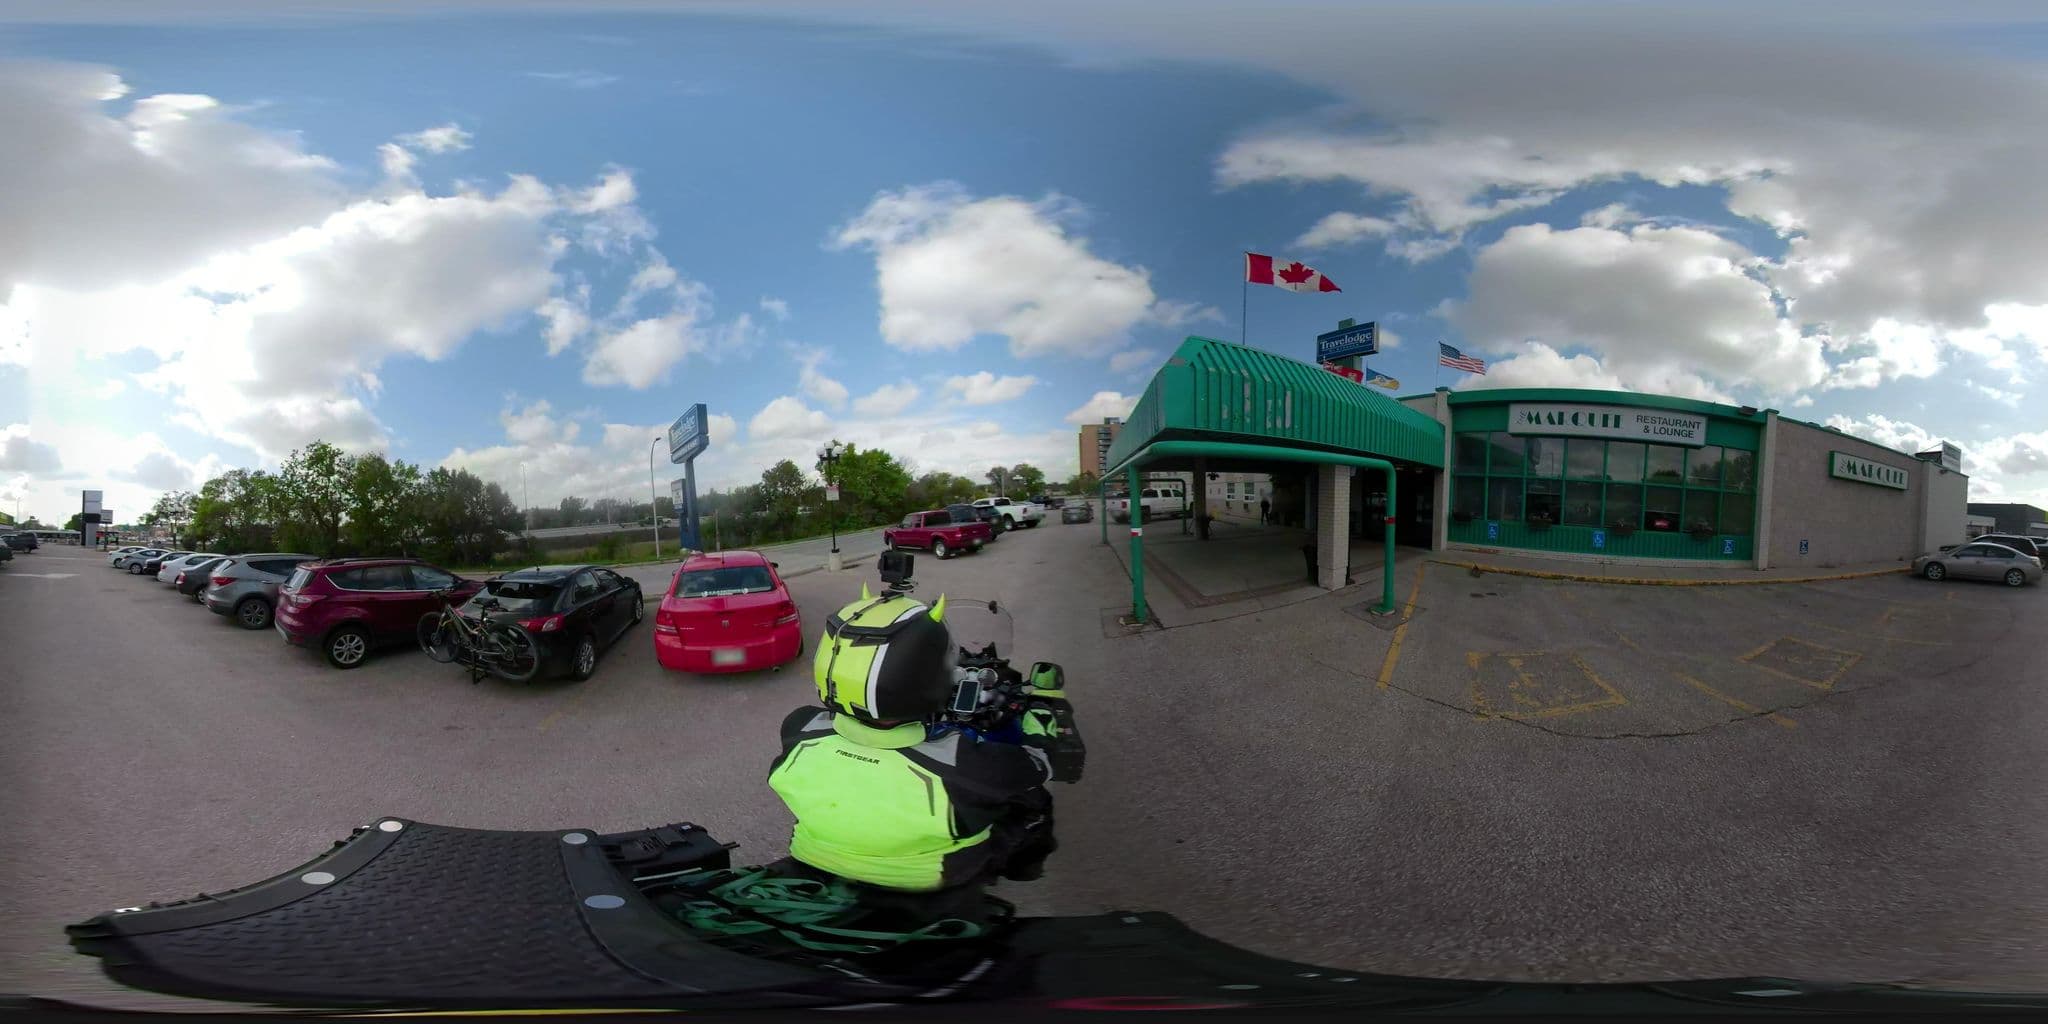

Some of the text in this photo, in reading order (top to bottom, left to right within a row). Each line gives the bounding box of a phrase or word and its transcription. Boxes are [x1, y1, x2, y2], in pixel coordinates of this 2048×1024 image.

[1320, 332, 1371, 350] Travelodge
[1636, 415, 1701, 430] RESTAURANT
[1643, 425, 1694, 439] & LOUNGE
